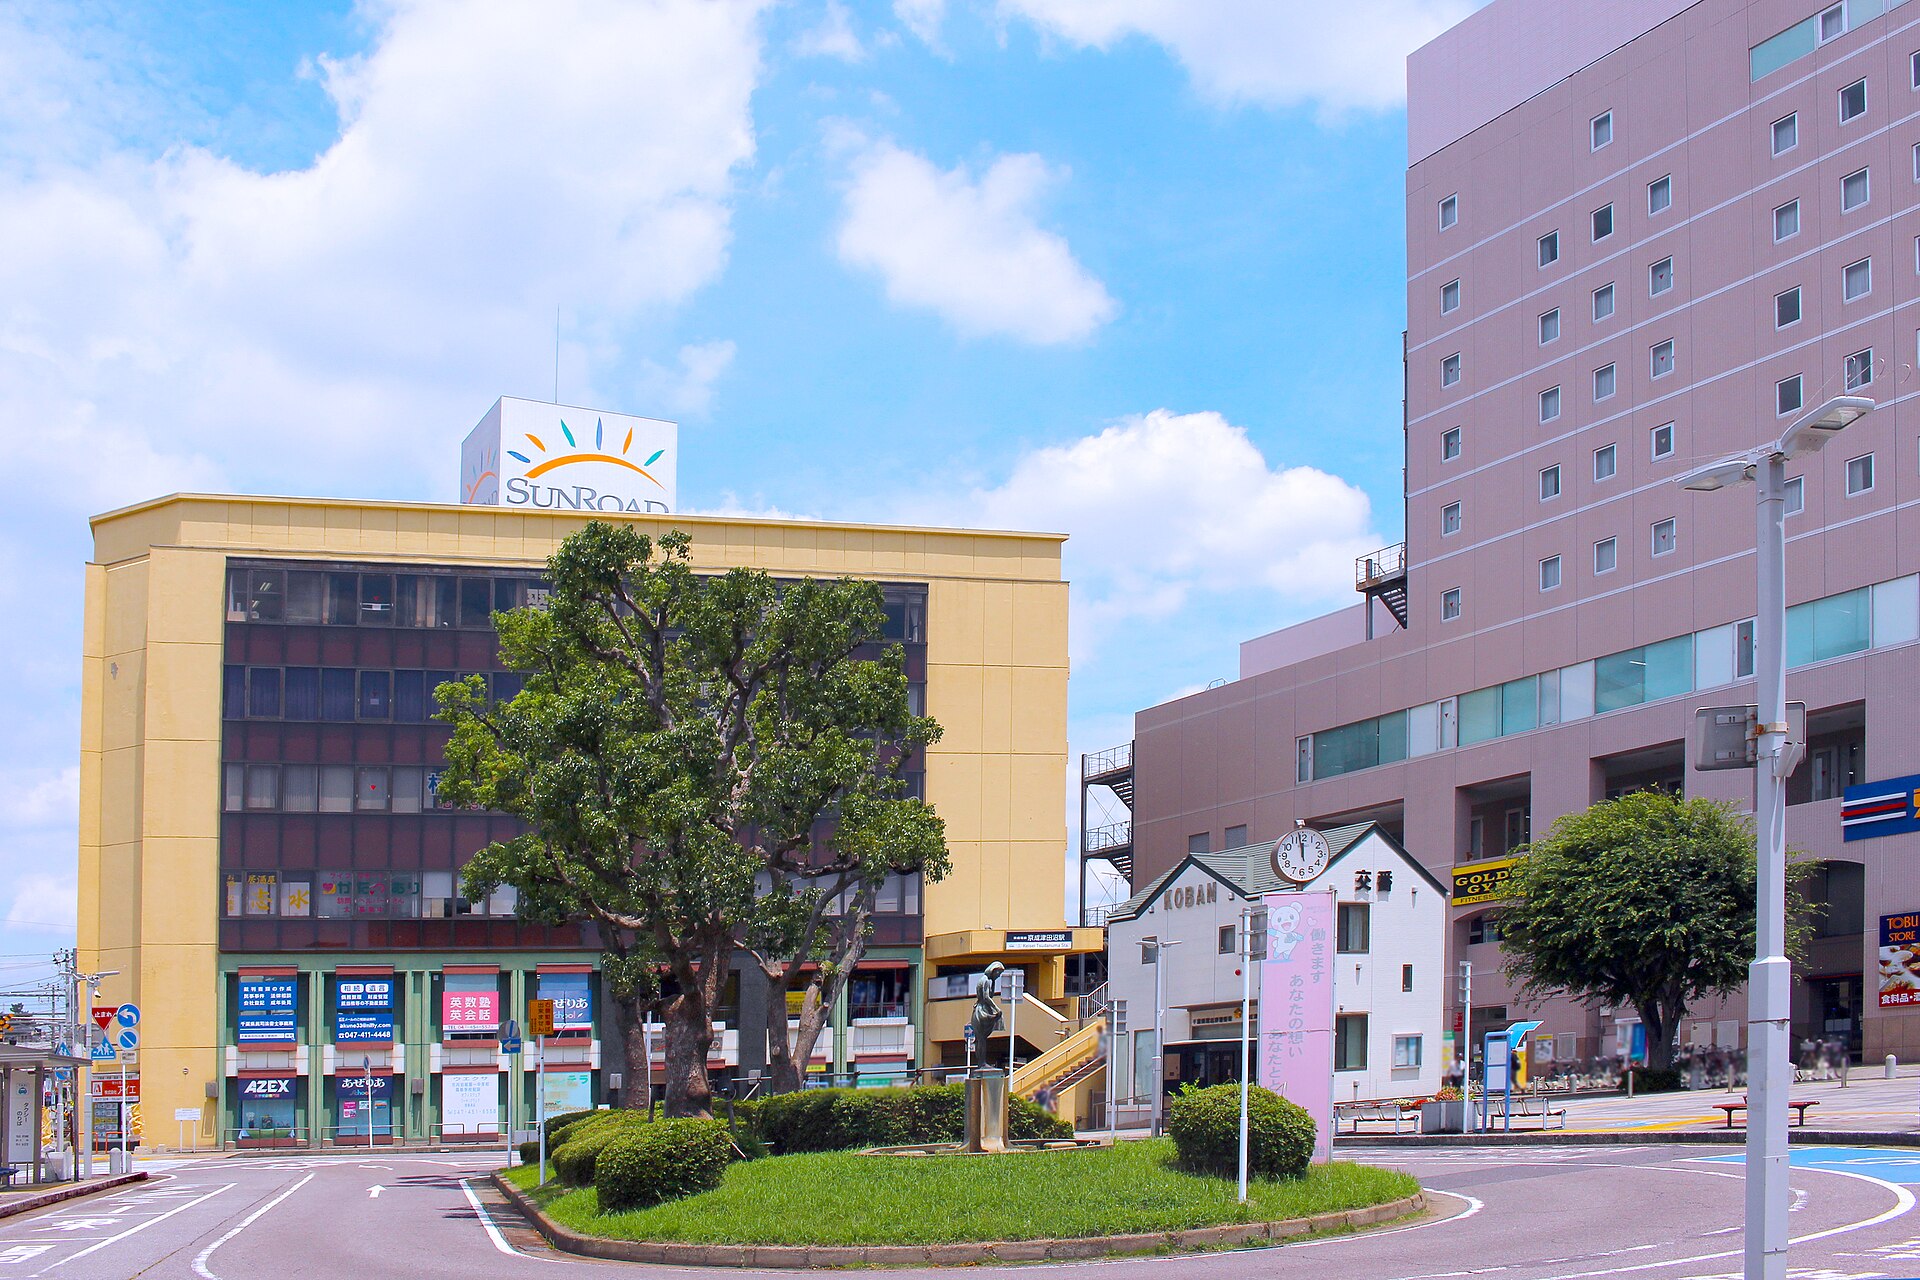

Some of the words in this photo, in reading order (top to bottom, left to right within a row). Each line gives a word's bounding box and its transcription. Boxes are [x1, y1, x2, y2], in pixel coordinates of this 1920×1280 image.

[1282, 843, 1292, 851] 10
[1281, 852, 1288, 860] 9
[1317, 850, 1324, 858] 3
[1284, 860, 1291, 868] 8
[1314, 859, 1320, 867] 4
[1299, 868, 1305, 876] 6
[1354, 869, 1393, 892] 交番
[1163, 881, 1217, 911] KOBAN
[1886, 914, 1919, 930] TOBU
[1888, 930, 1916, 942] STORE
[1311, 927, 1325, 984] 働きます
[344, 984, 361, 992] 相続
[368, 984, 385, 992] 遺言
[450, 996, 491, 1008] 英数塾
[544, 997, 589, 1009] ぜりあ
[450, 1009, 491, 1021] 英会話
[1288, 974, 1304, 1057] あなたの想い
[243, 1079, 290, 1094] AZEX
